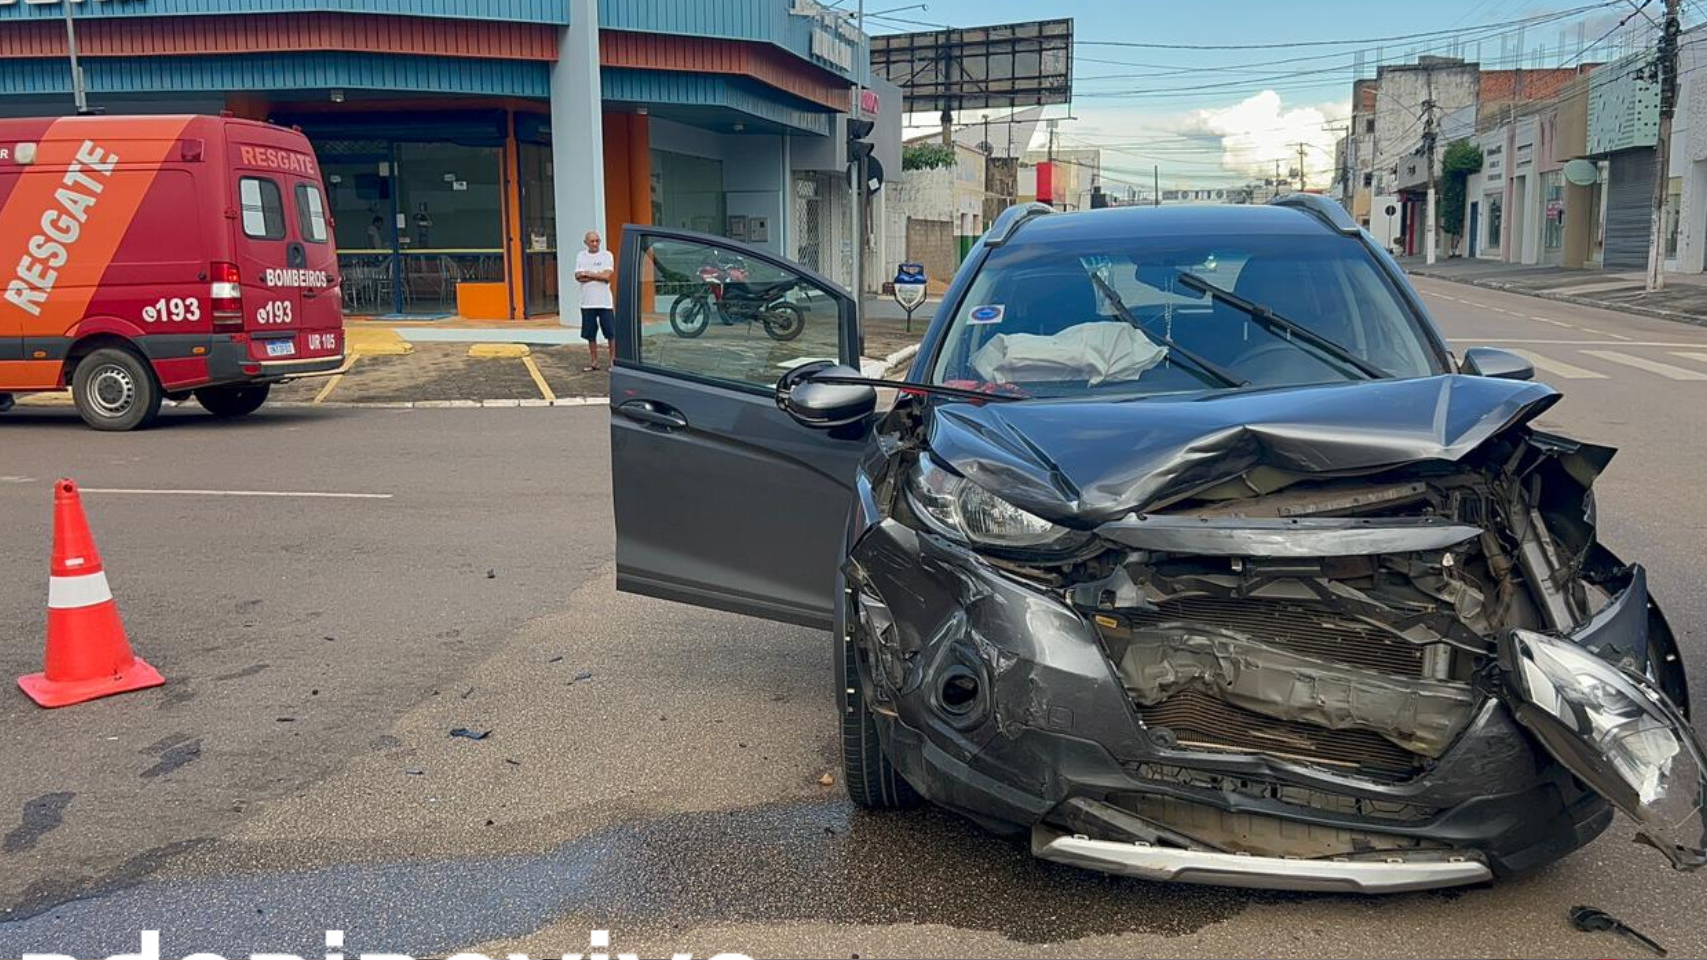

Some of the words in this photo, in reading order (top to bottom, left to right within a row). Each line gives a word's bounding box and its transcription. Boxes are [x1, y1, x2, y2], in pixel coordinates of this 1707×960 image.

[240, 145, 315, 174] RESGATE
[3, 139, 119, 317] RESGATE
[266, 268, 327, 287] BOMBEIROS
[156, 298, 200, 321] 193
[266, 301, 292, 323] 193
[308, 333, 321, 350] UR
